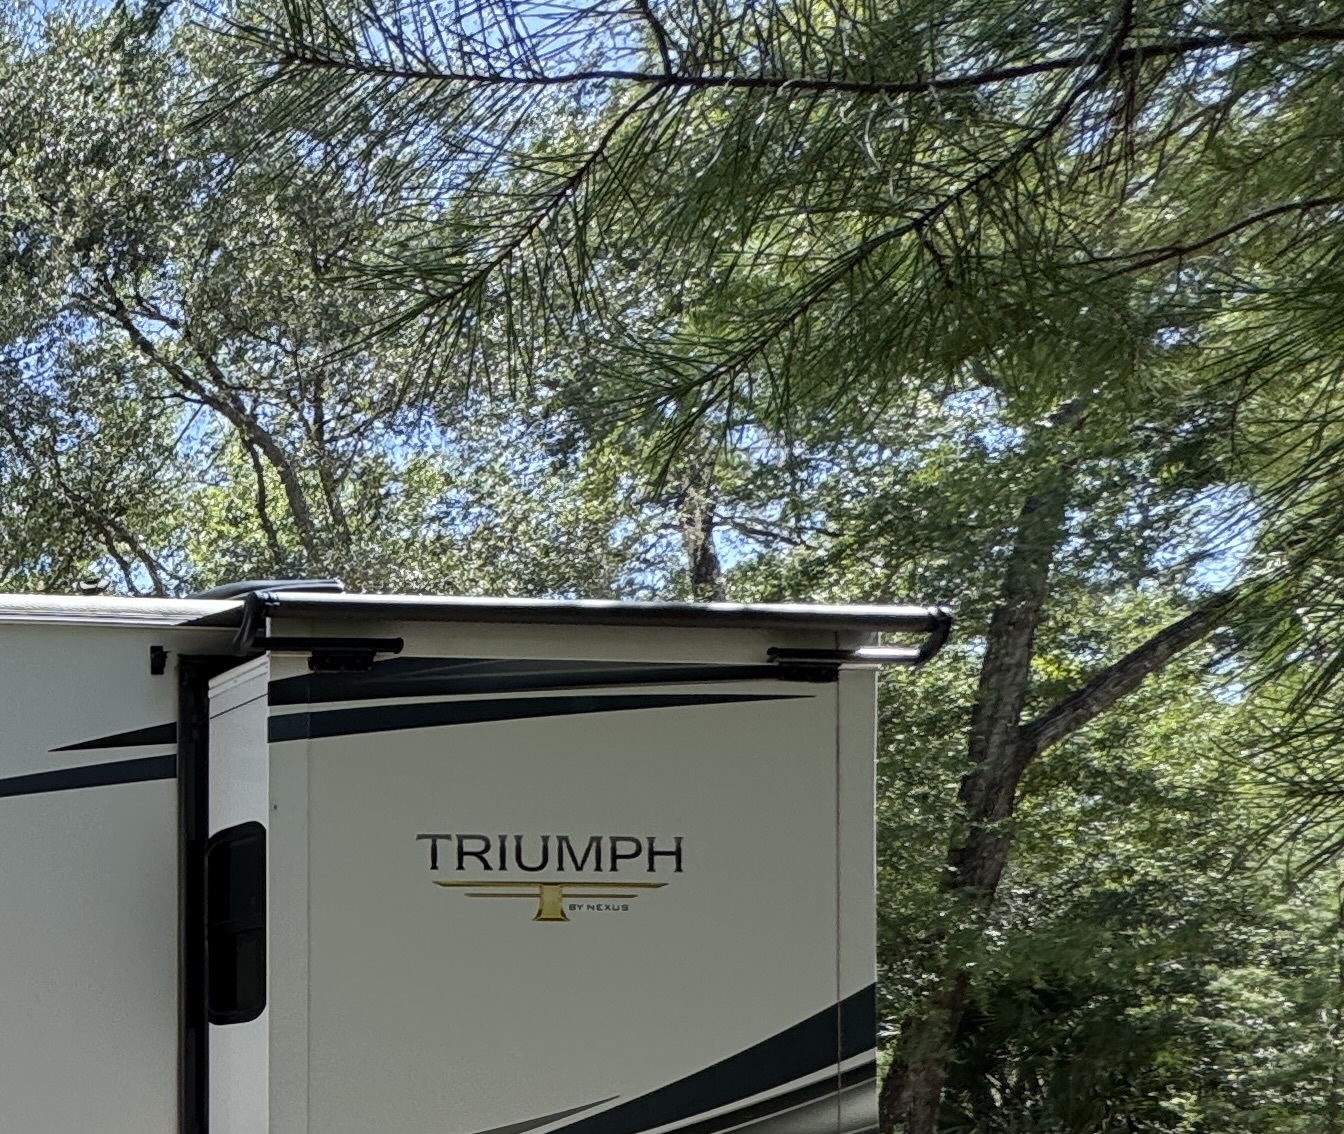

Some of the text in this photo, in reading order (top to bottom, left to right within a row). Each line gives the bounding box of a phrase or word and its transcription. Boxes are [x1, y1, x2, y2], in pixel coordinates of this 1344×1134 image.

[415, 833, 684, 873] TRIUMPH
[568, 903, 629, 912] BY NEXUS
